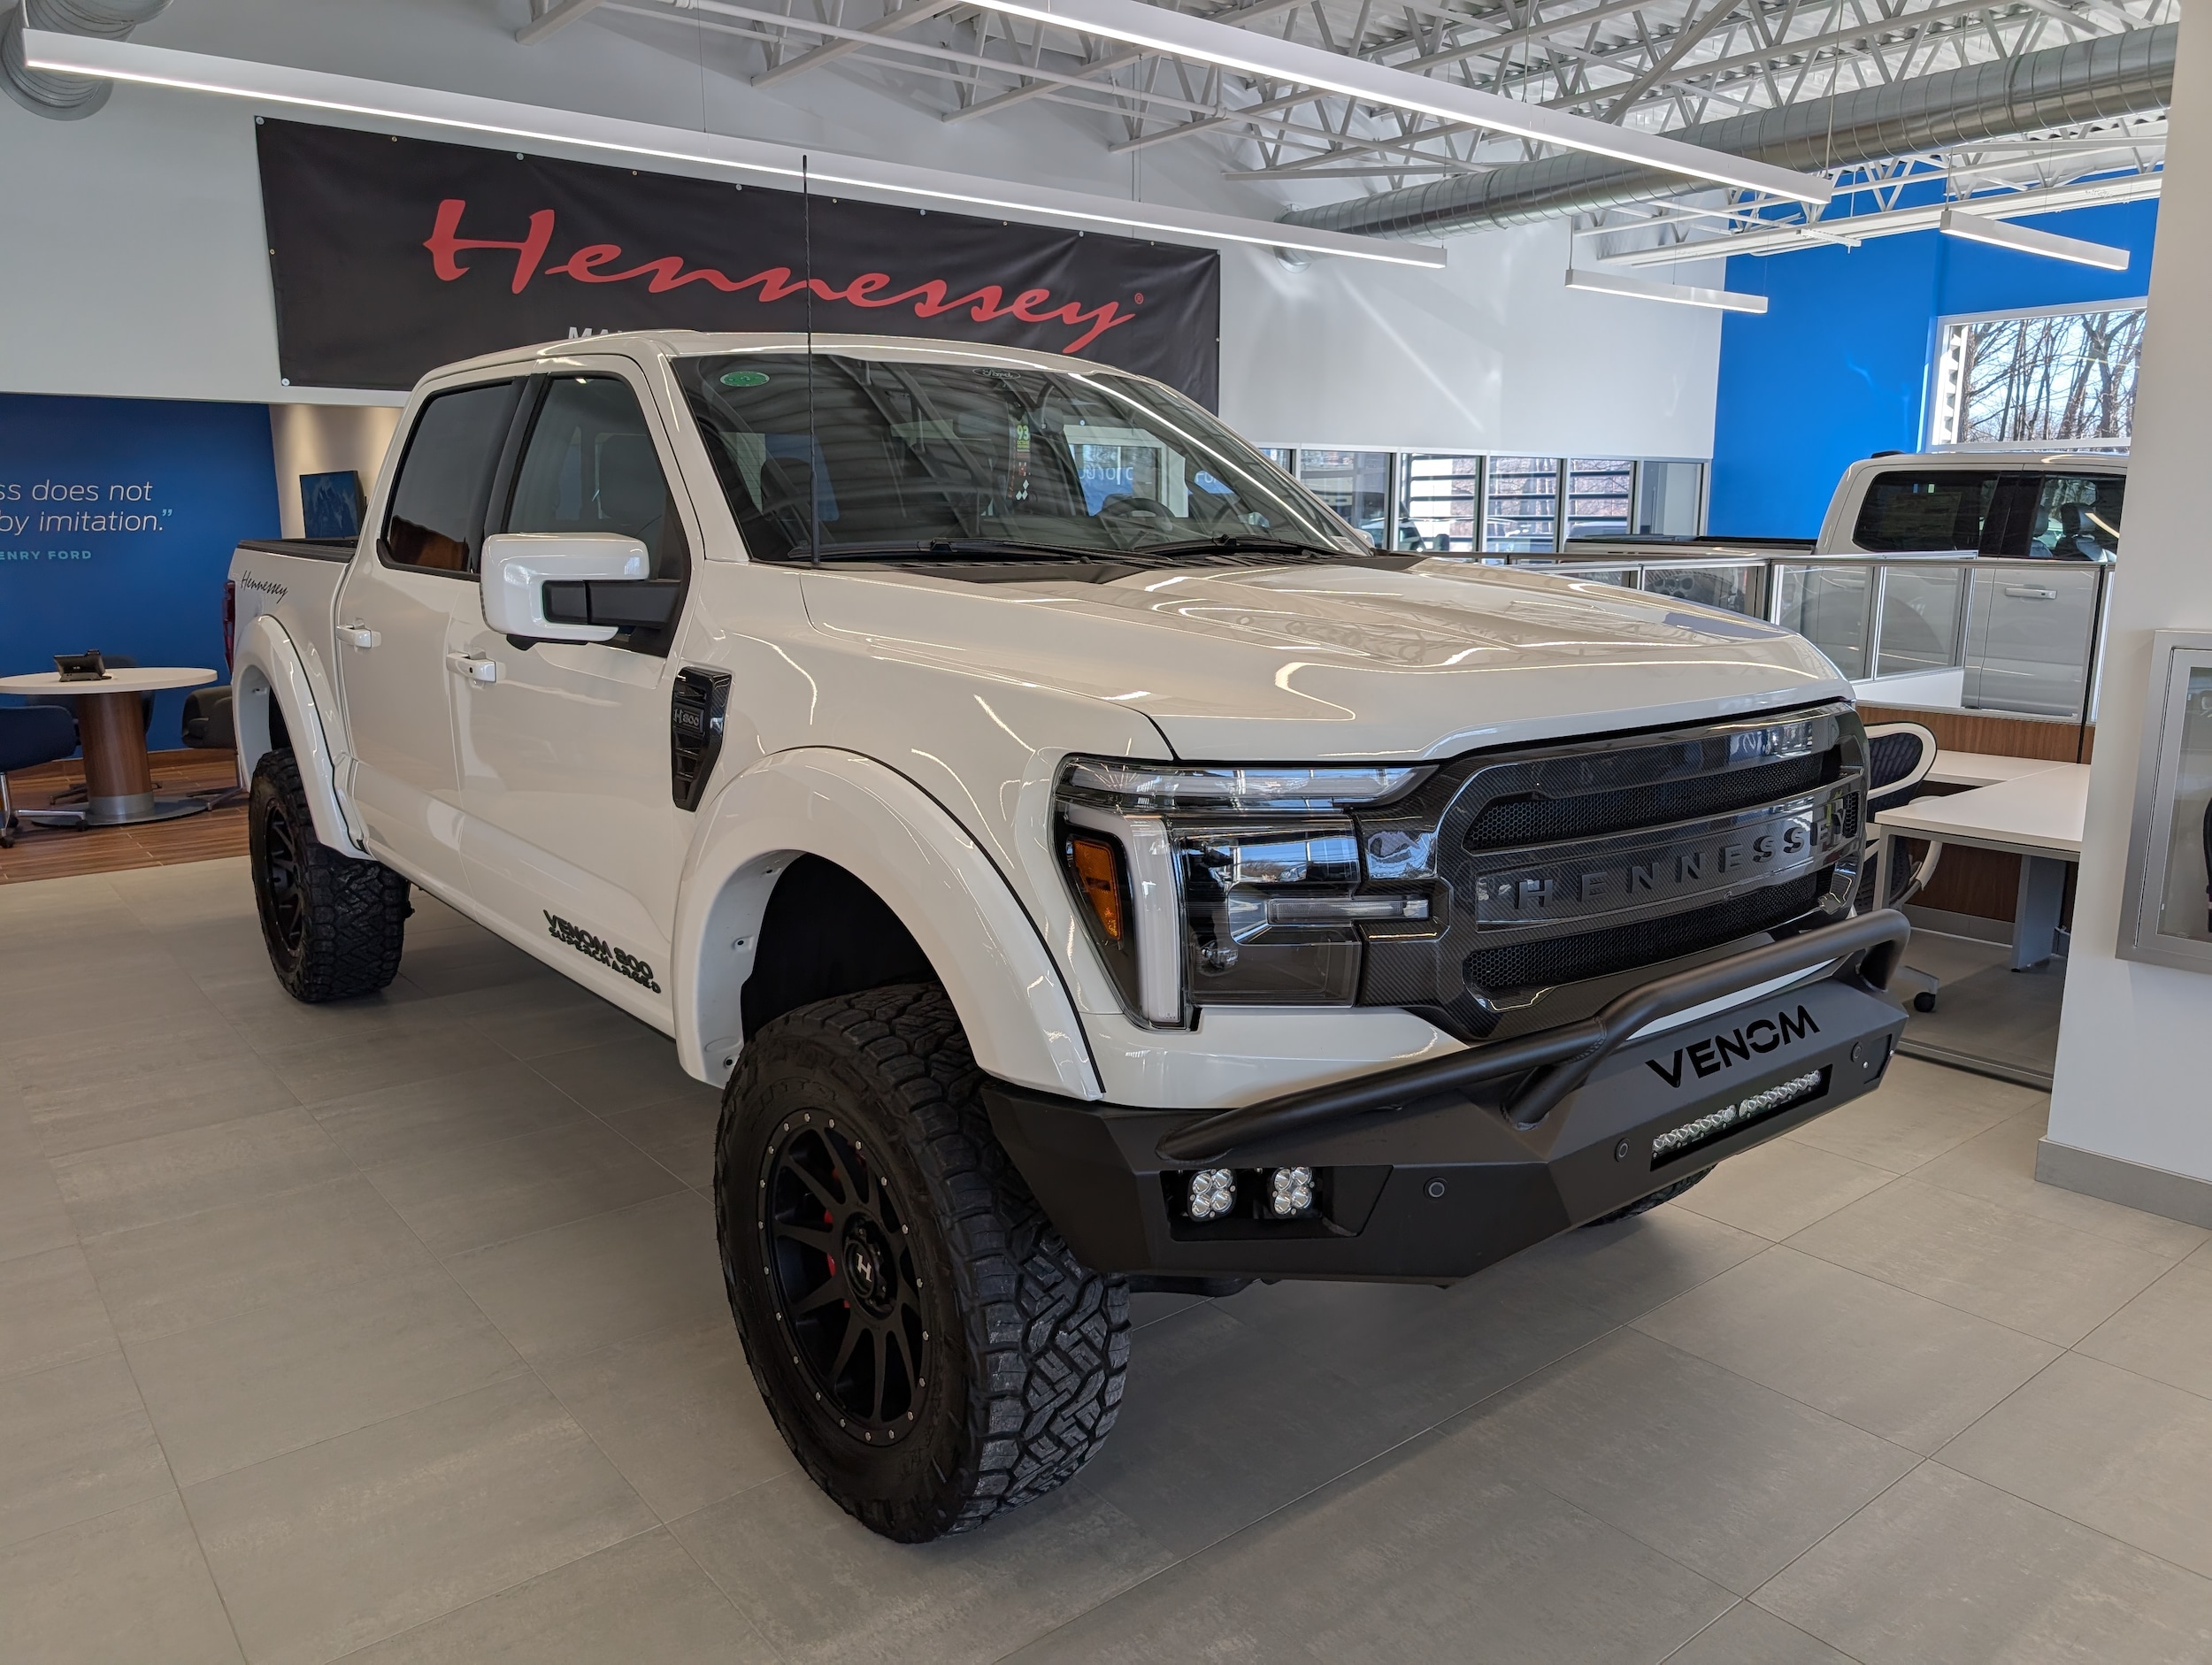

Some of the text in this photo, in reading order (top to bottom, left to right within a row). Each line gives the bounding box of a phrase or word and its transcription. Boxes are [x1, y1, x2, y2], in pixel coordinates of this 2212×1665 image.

[423, 198, 1136, 354] Hennessey
[1017, 425, 1030, 441] 93
[32, 479, 100, 502] does
[109, 481, 153, 502] not
[0, 510, 30, 536] by
[48, 550, 92, 560] FORD
[241, 570, 288, 605] Hennessey
[1517, 807, 1847, 910] HENNESSEY
[543, 909, 654, 979] VENOM 800
[1645, 1004, 1822, 1088] VENOM
